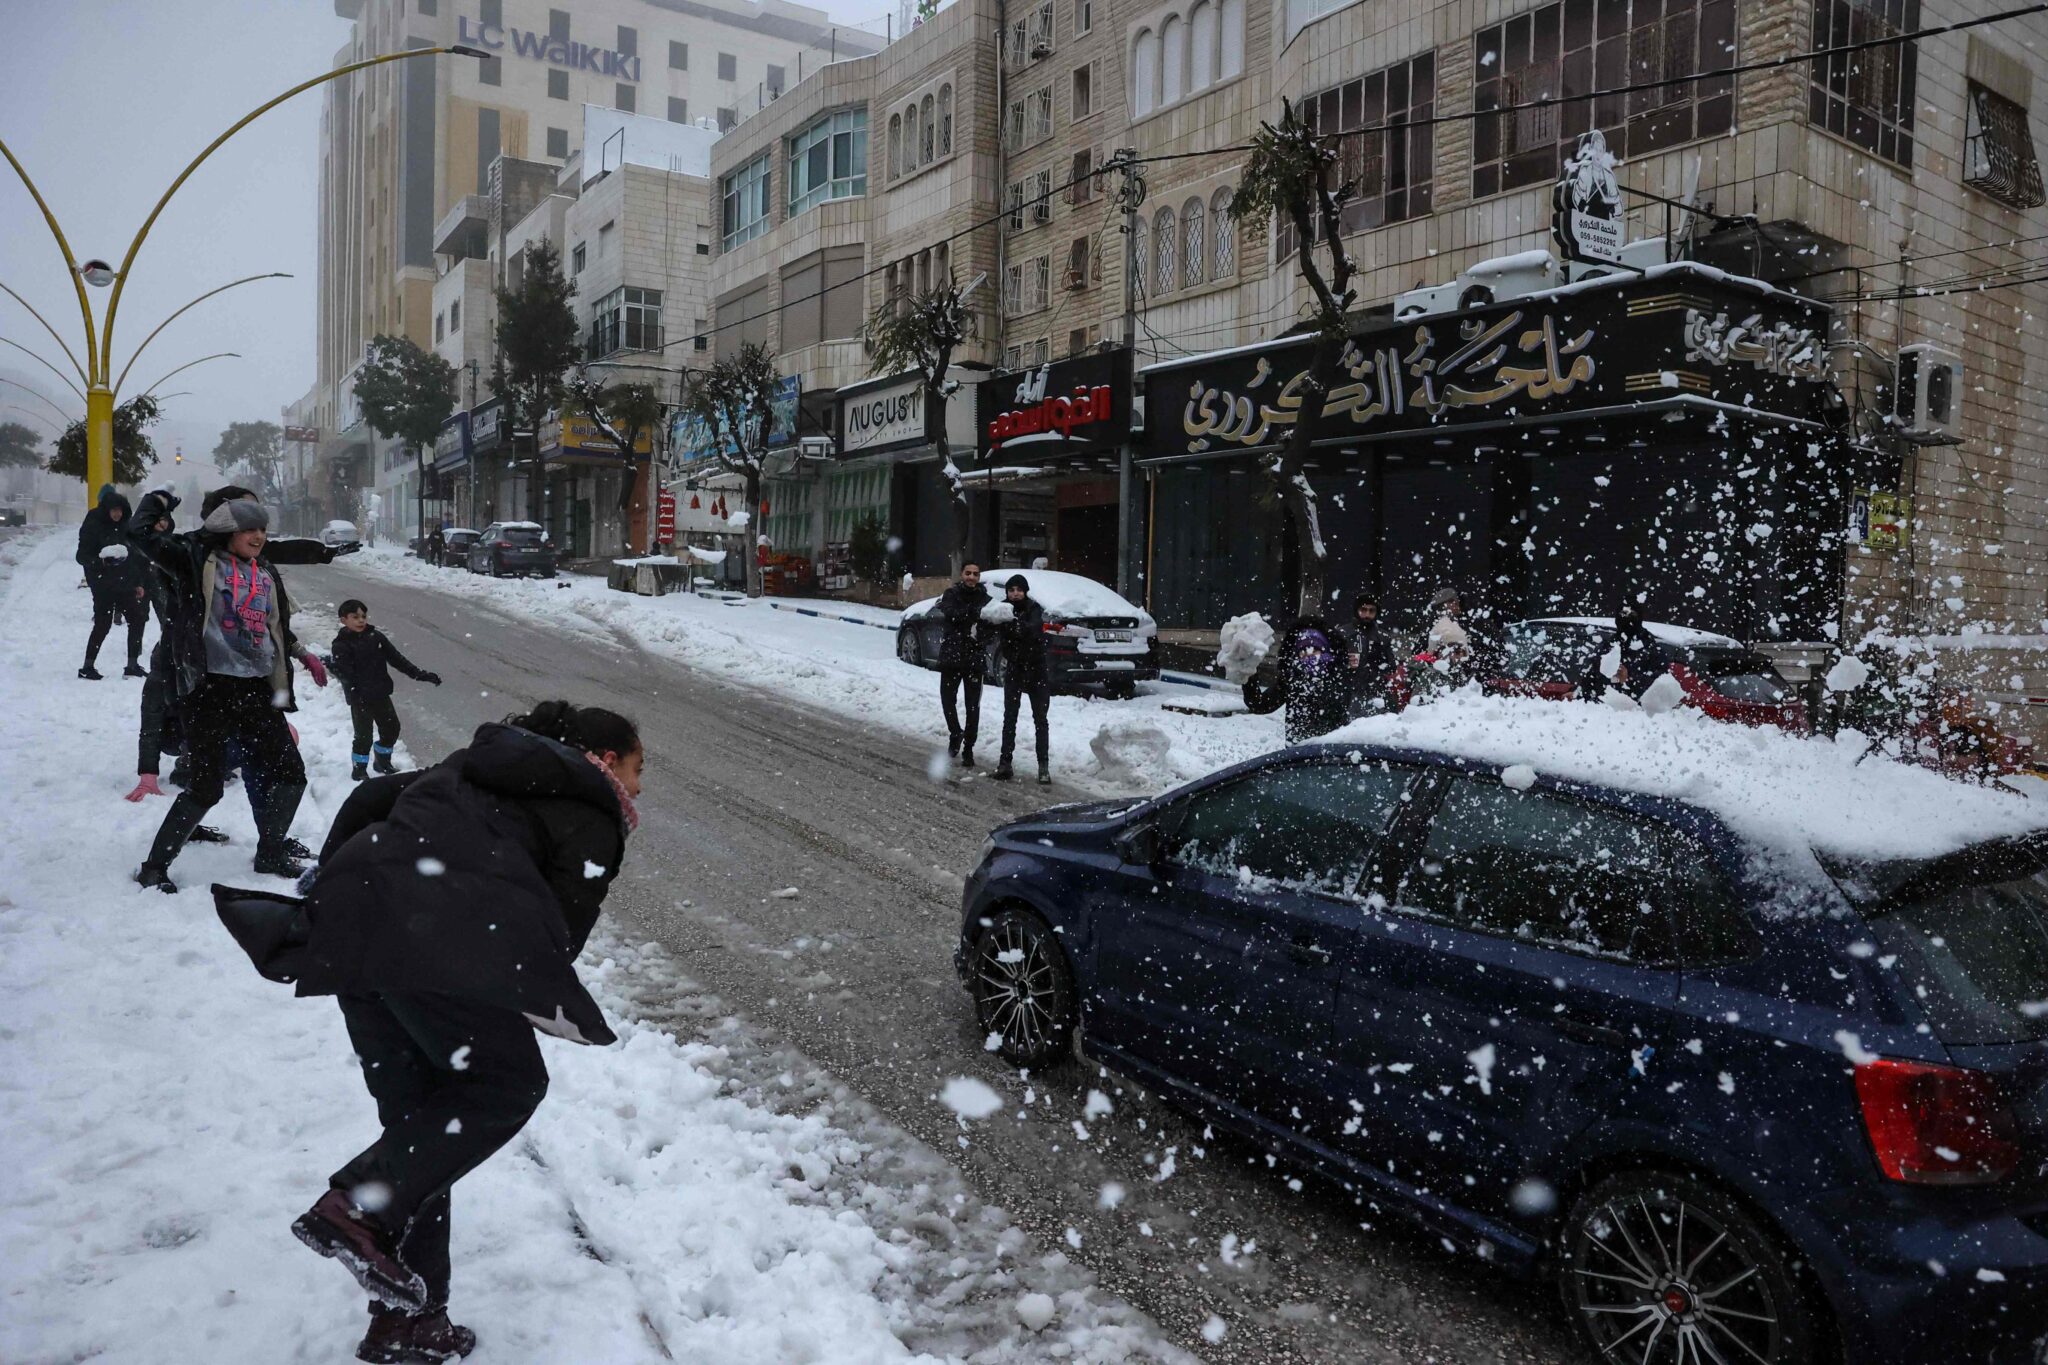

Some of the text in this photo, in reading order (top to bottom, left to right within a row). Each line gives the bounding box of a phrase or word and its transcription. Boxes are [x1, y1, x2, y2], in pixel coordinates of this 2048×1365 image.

[458, 15, 505, 49] LC
[849, 394, 919, 433] AUGUST
[988, 384, 1111, 449] القواسمي
